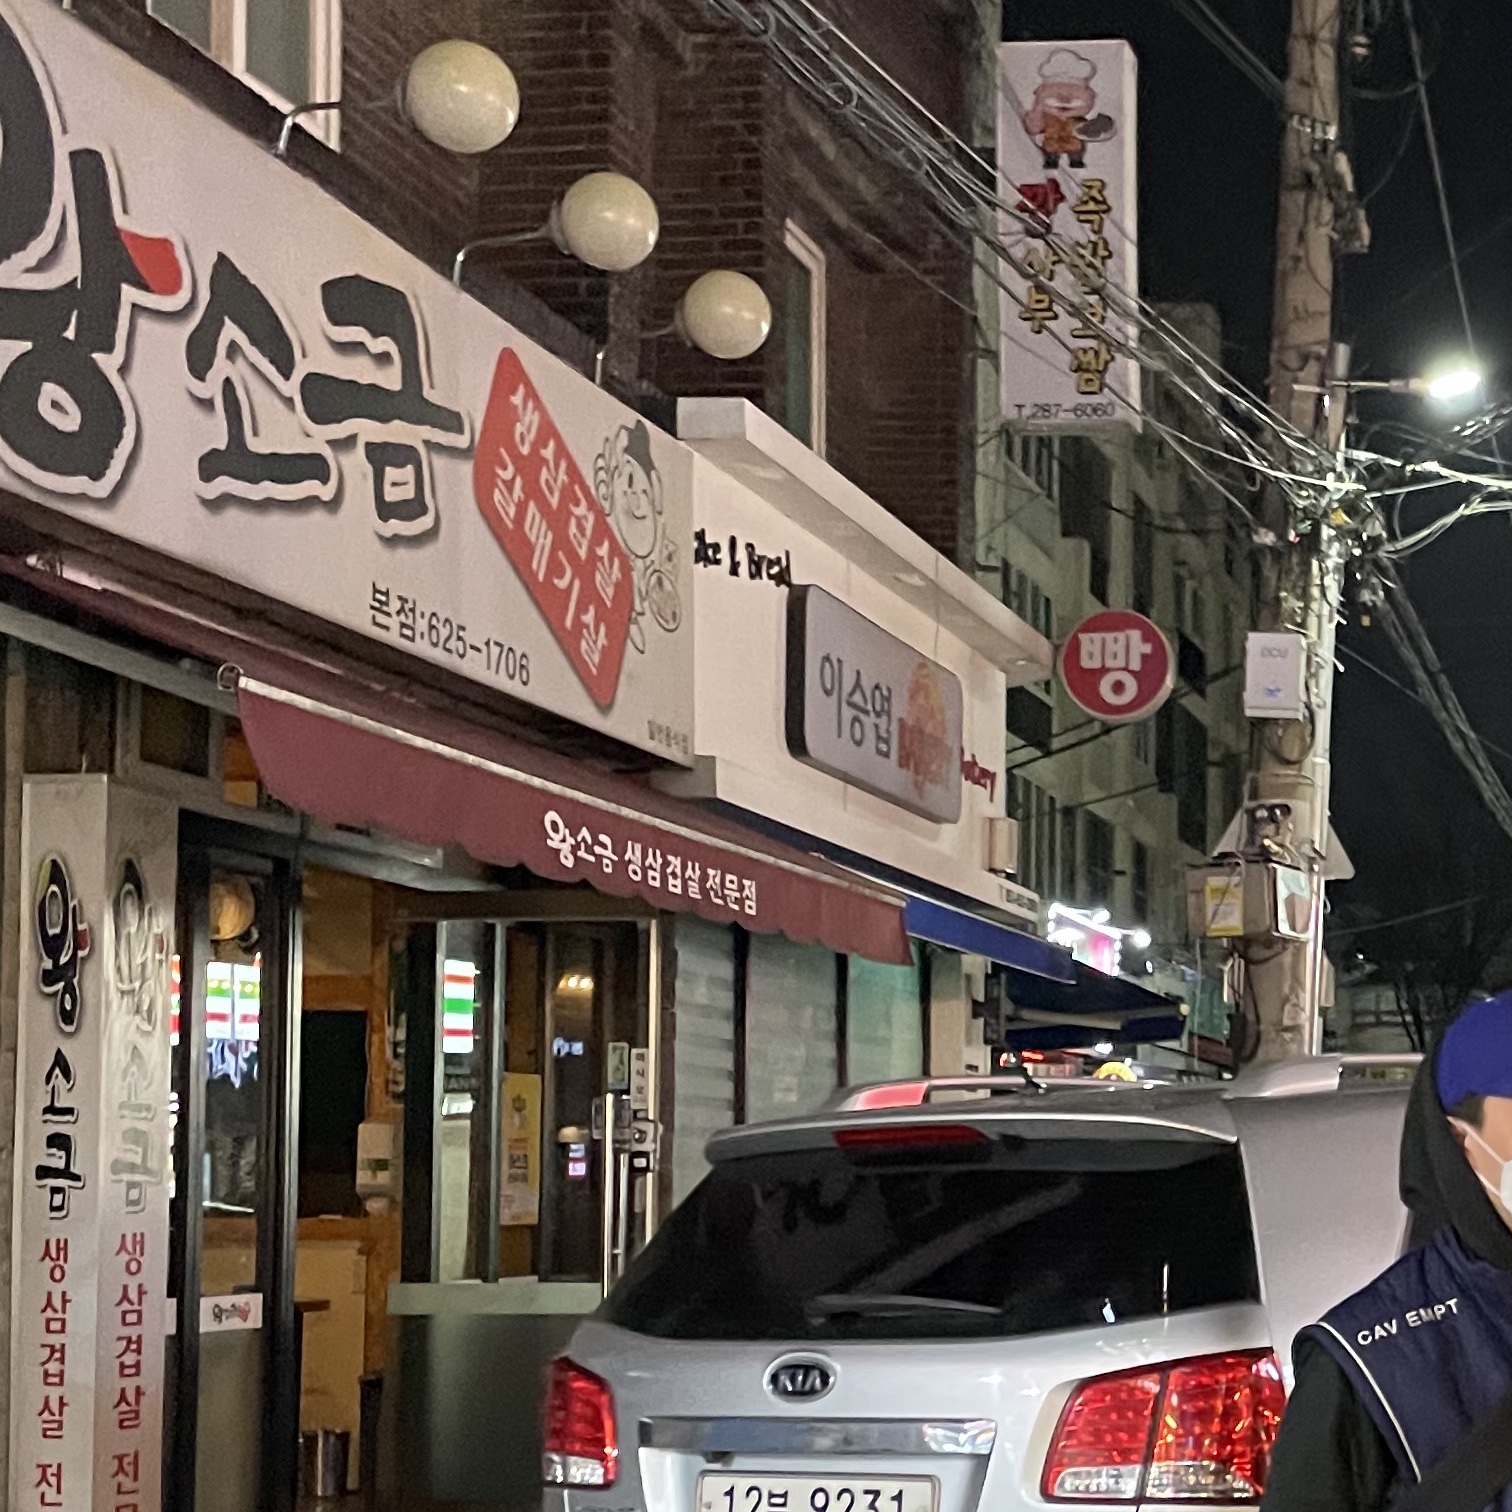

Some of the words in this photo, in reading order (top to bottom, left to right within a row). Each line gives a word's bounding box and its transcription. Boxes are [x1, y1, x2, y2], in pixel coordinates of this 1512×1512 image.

[493, 447, 608, 676] 갈매기살
[510, 383, 622, 608] 생삼겹살
[369, 581, 531, 687] 본점:625-1706
[1077, 628, 1154, 706] 빵
[543, 811, 618, 874] 왕소금
[624, 840, 703, 900] 생삼겹살
[706, 867, 757, 916] 전문점
[36, 857, 90, 1218] 왕소금
[37, 1237, 73, 1440] 생삼겹살
[112, 1231, 149, 1431] 생삼겹살
[1356, 1318, 1399, 1347] CAV
[1404, 1297, 1460, 1329] EMPT
